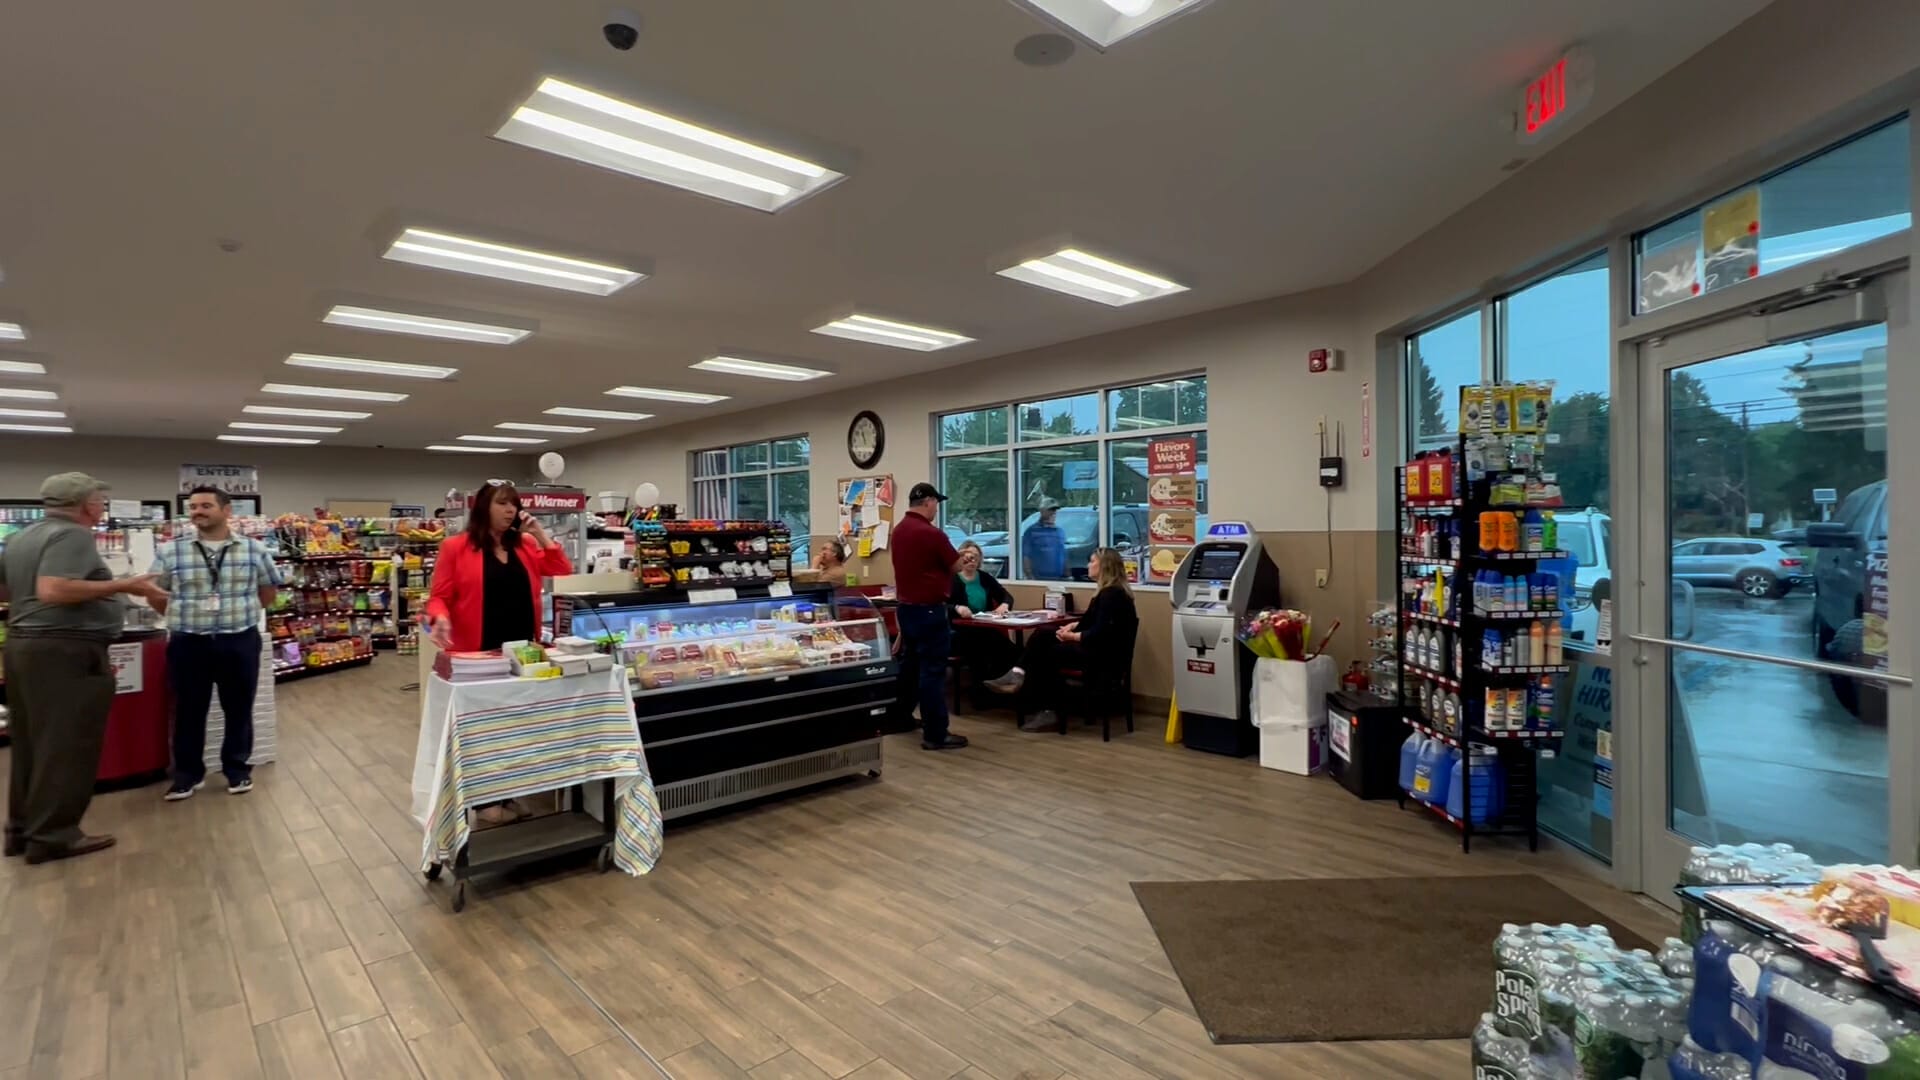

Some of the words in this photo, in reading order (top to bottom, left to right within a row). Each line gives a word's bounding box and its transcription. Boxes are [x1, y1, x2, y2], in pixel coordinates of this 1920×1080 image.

[1525, 57, 1568, 135] EXIT
[1154, 442, 1191, 453] Flavors
[1156, 451, 1188, 463] Week
[196, 466, 240, 476] ENTER
[533, 494, 579, 508] Warmer
[1216, 524, 1240, 534] ATM
[1577, 684, 1611, 713] HIR
